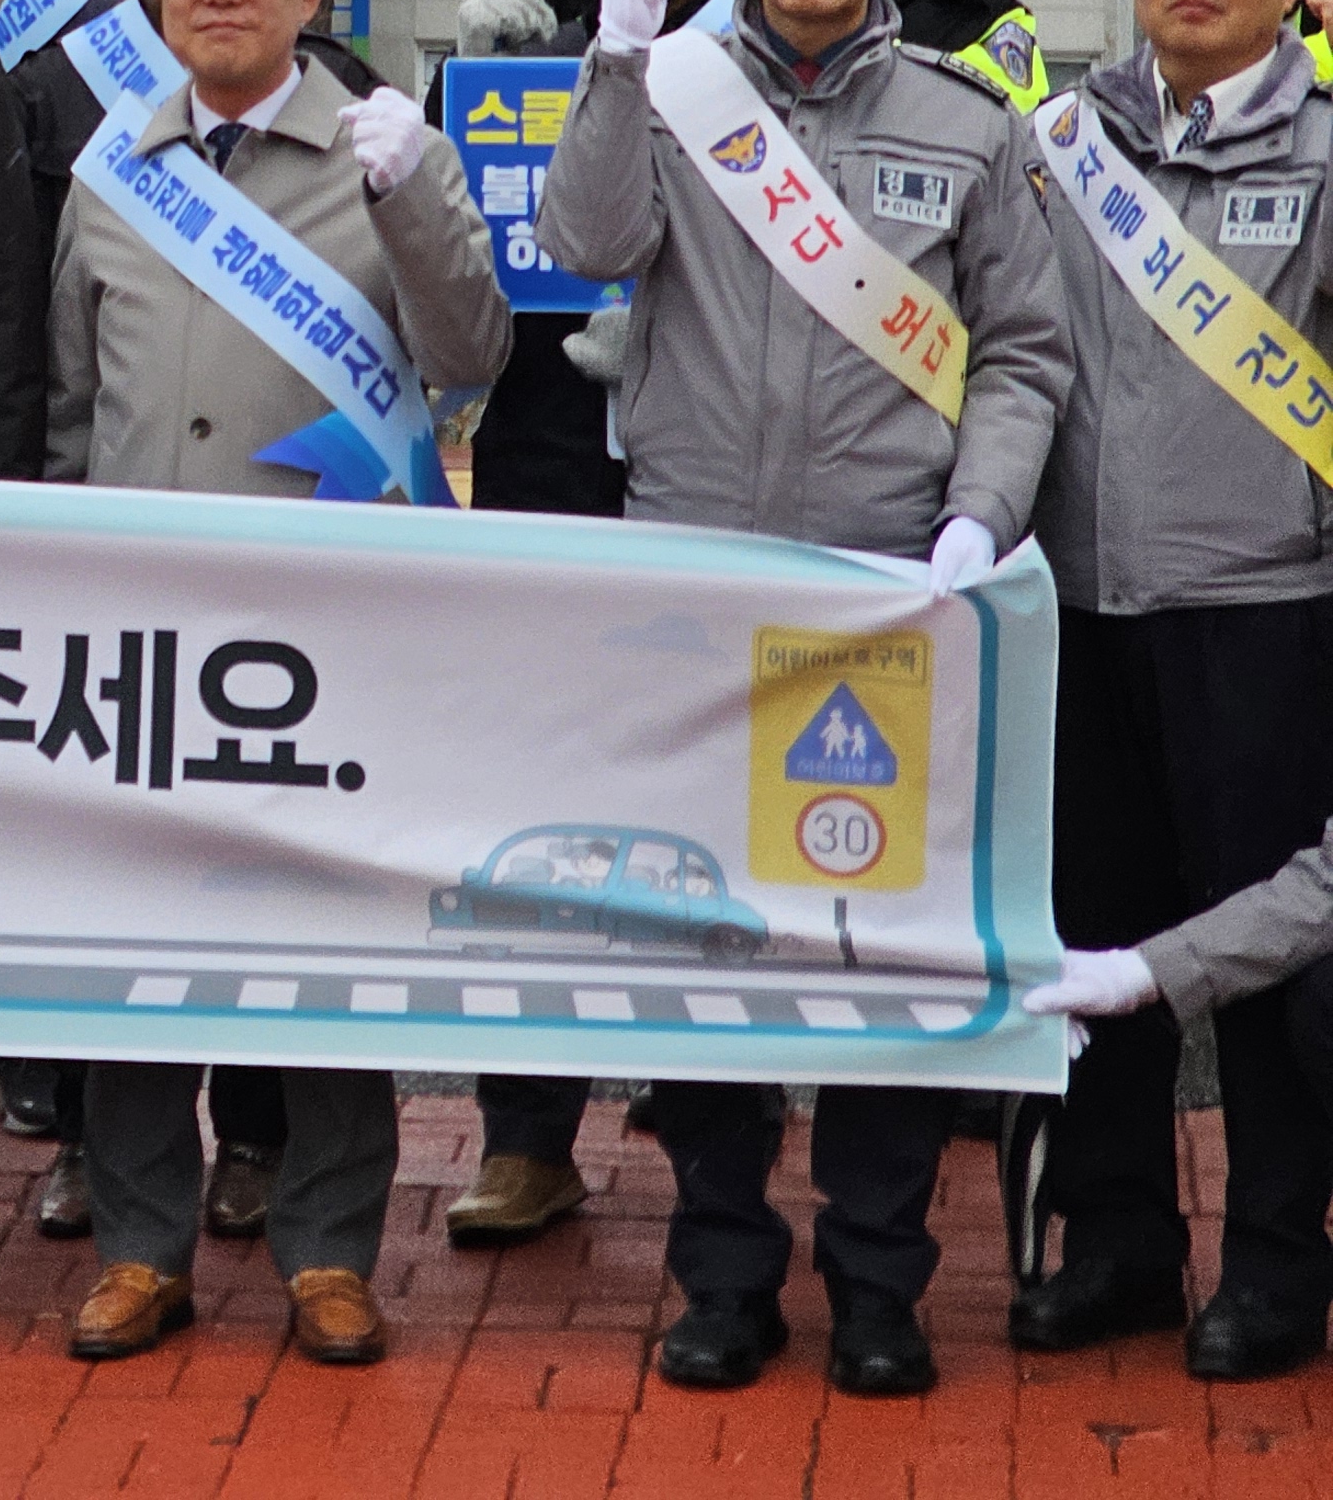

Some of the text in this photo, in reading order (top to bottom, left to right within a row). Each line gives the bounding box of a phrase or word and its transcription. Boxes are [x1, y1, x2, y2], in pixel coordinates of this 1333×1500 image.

[881, 200, 943, 221] POLICE
[1229, 228, 1293, 240] POLICE
[211, 222, 402, 420] 생활화합시다
[813, 809, 871, 857] 30
